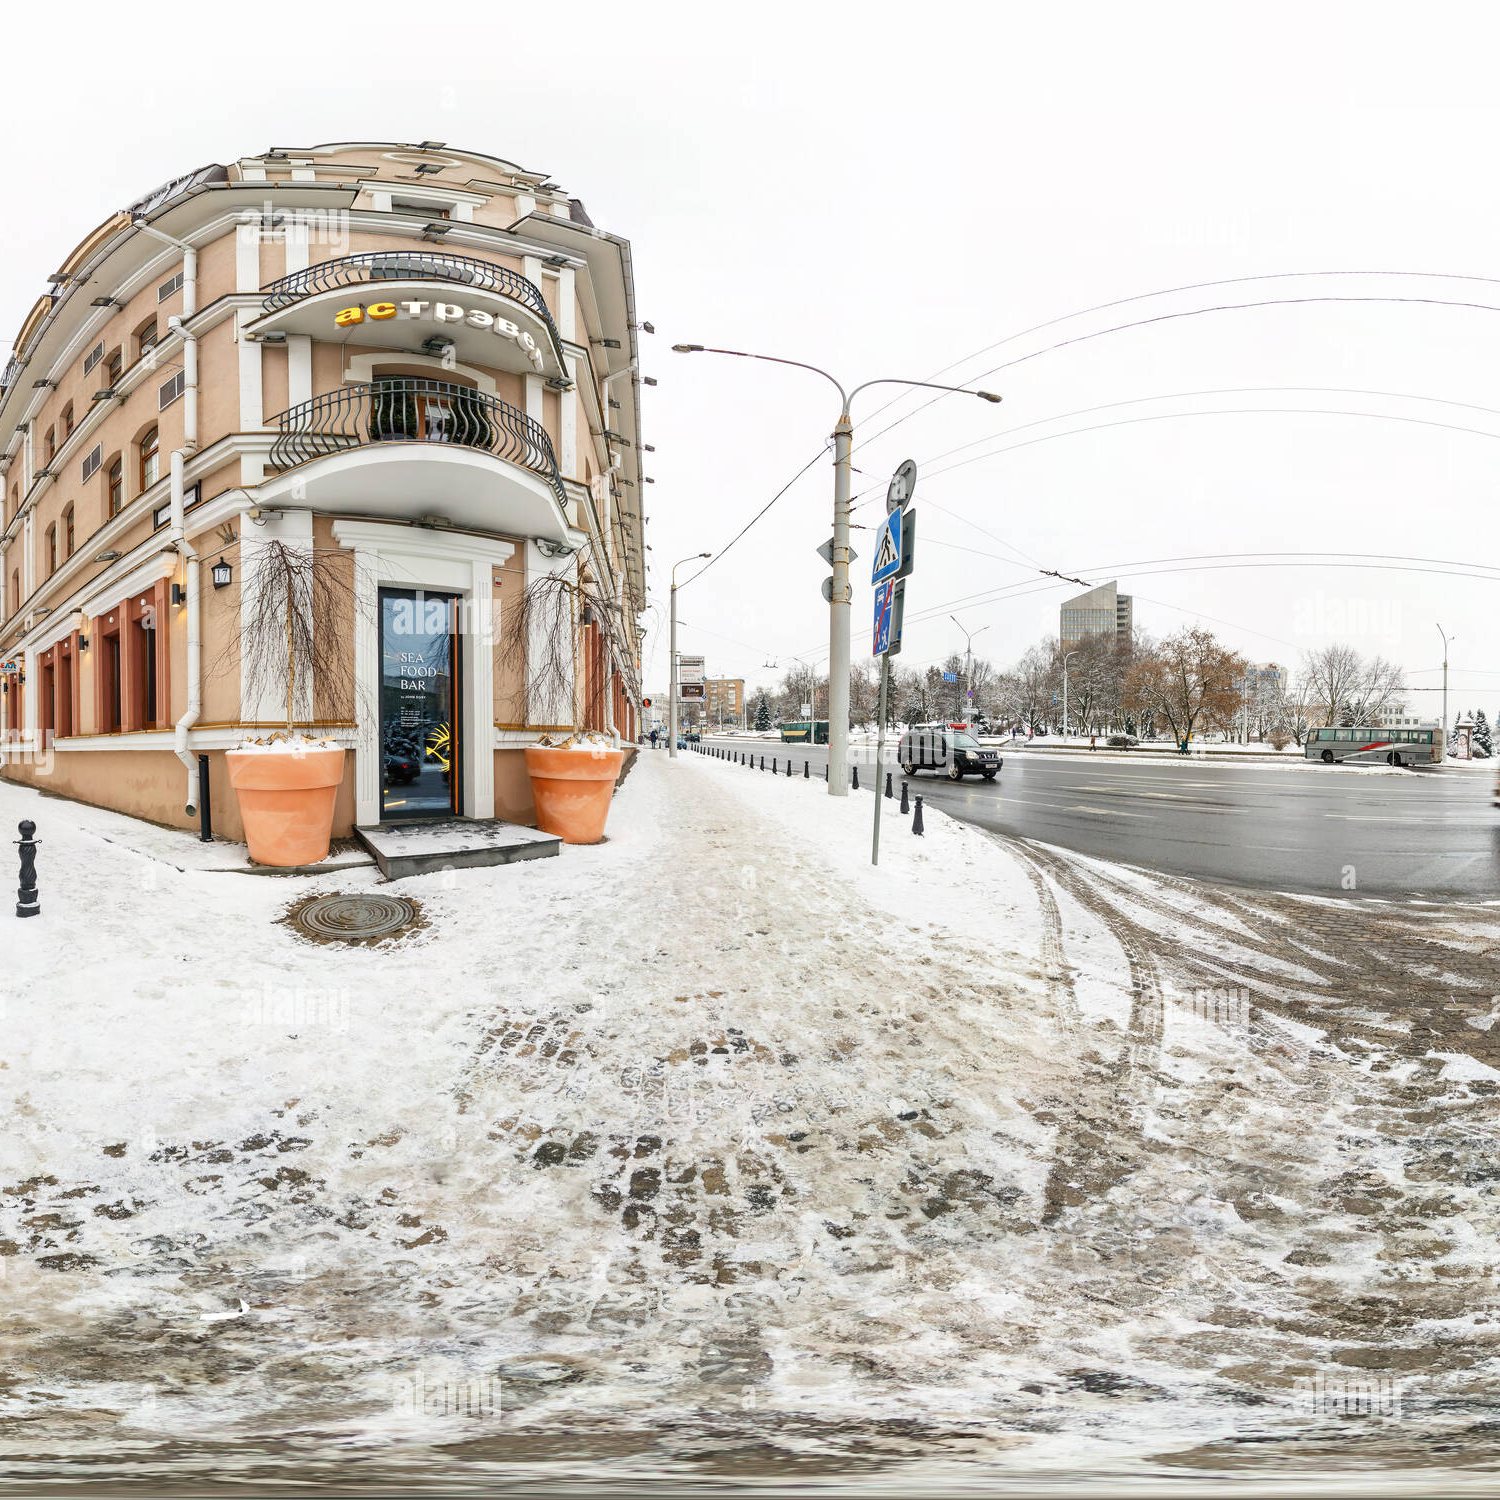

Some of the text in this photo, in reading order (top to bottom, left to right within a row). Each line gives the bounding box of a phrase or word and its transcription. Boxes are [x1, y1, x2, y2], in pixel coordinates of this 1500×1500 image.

[216, 569, 228, 581] 17
[401, 653, 424, 663] SEA
[401, 666, 437, 677] FOOD
[401, 680, 426, 691] BAR
